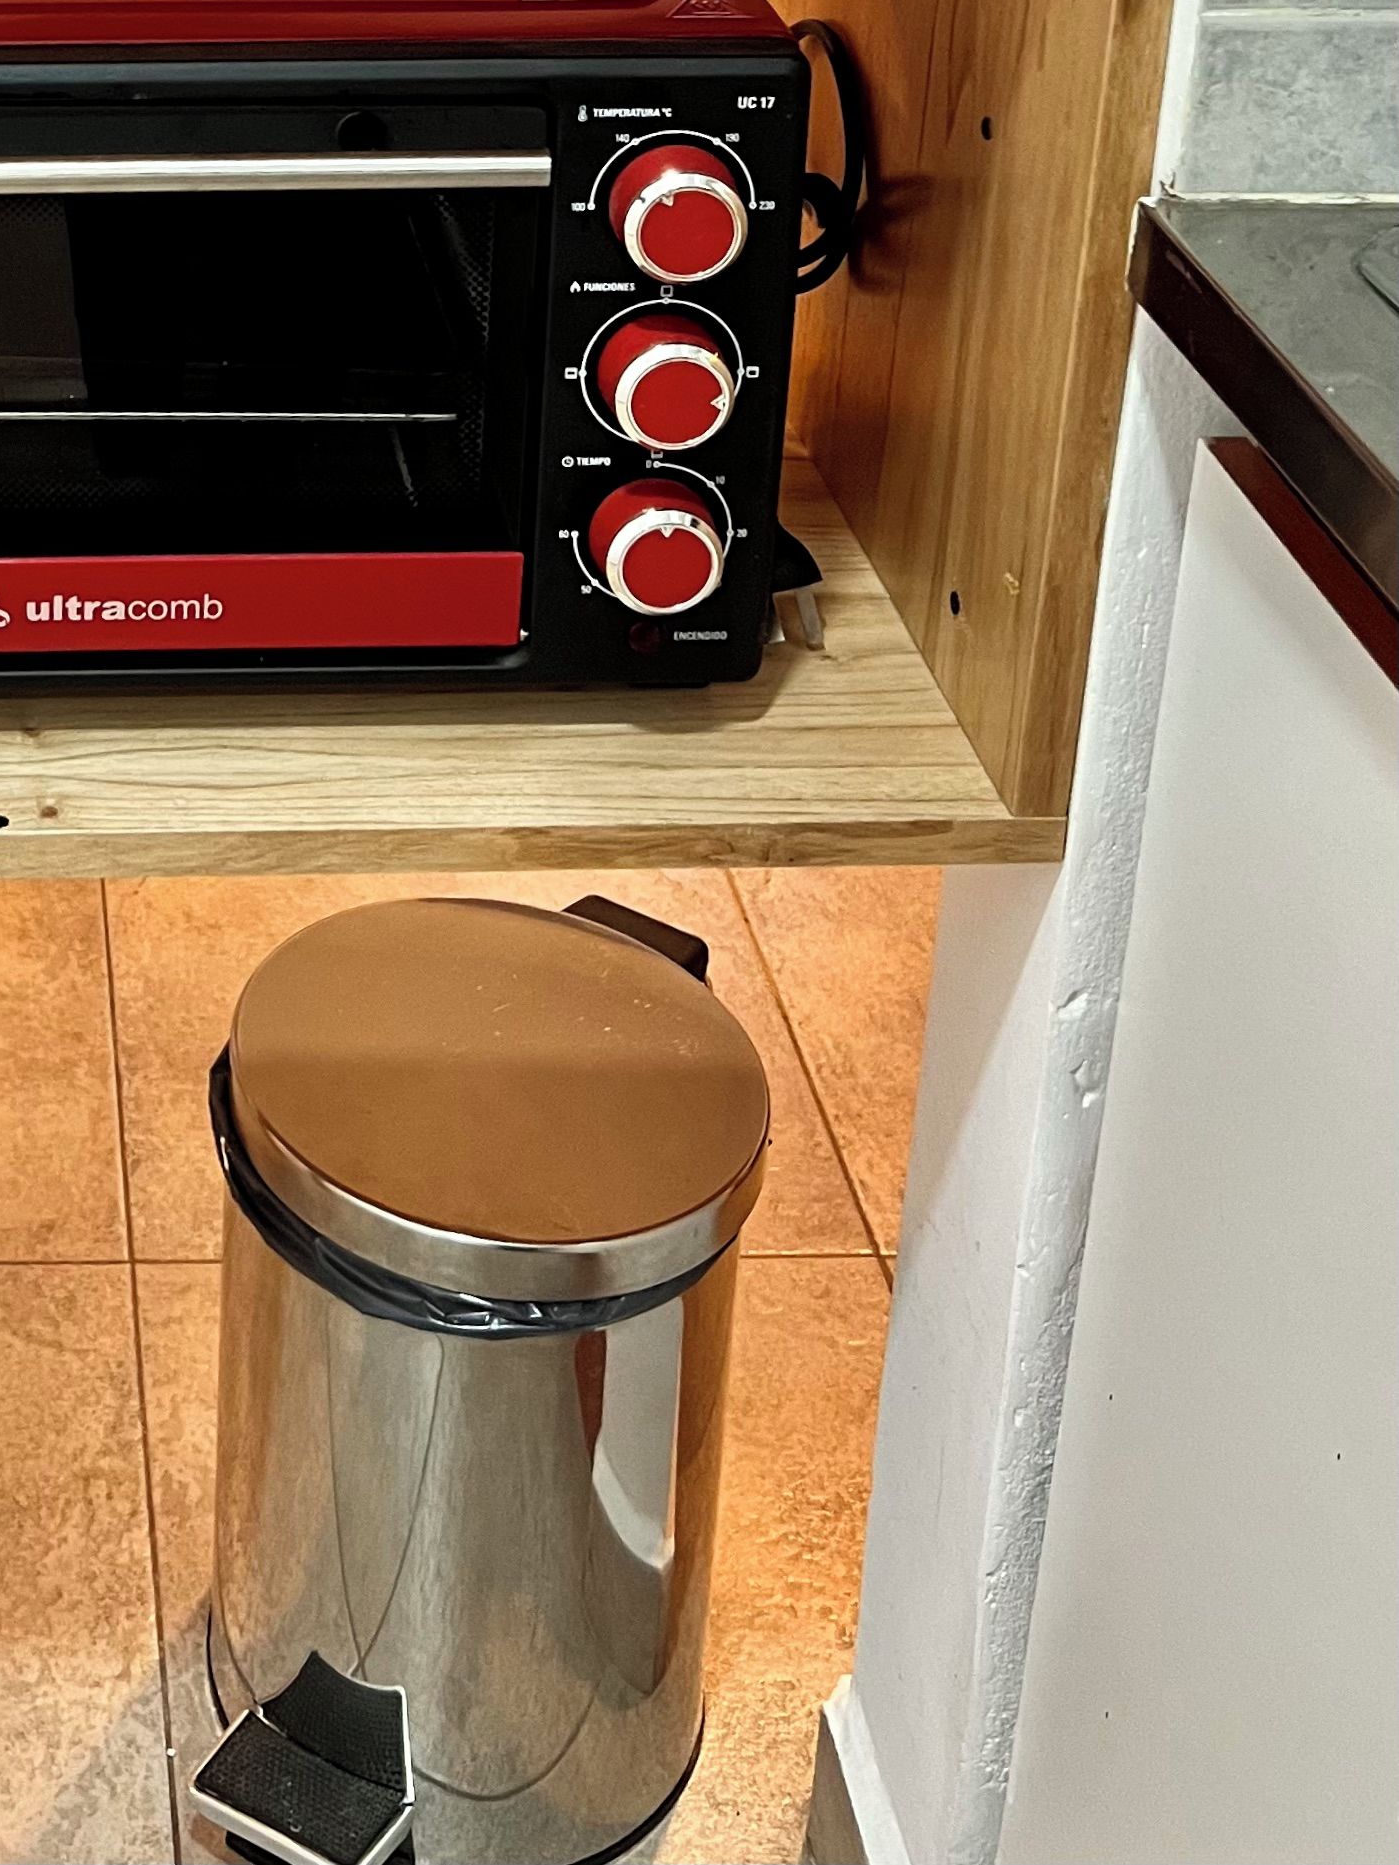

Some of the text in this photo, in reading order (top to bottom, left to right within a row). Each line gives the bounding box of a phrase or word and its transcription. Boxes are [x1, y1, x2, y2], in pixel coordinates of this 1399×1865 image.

[737, 96, 776, 109] UC 17
[593, 107, 660, 118] TEMPERATURA
[583, 281, 636, 293] FUNCIONES
[576, 456, 611, 467] TIEMPO
[25, 593, 223, 621] ultracomb
